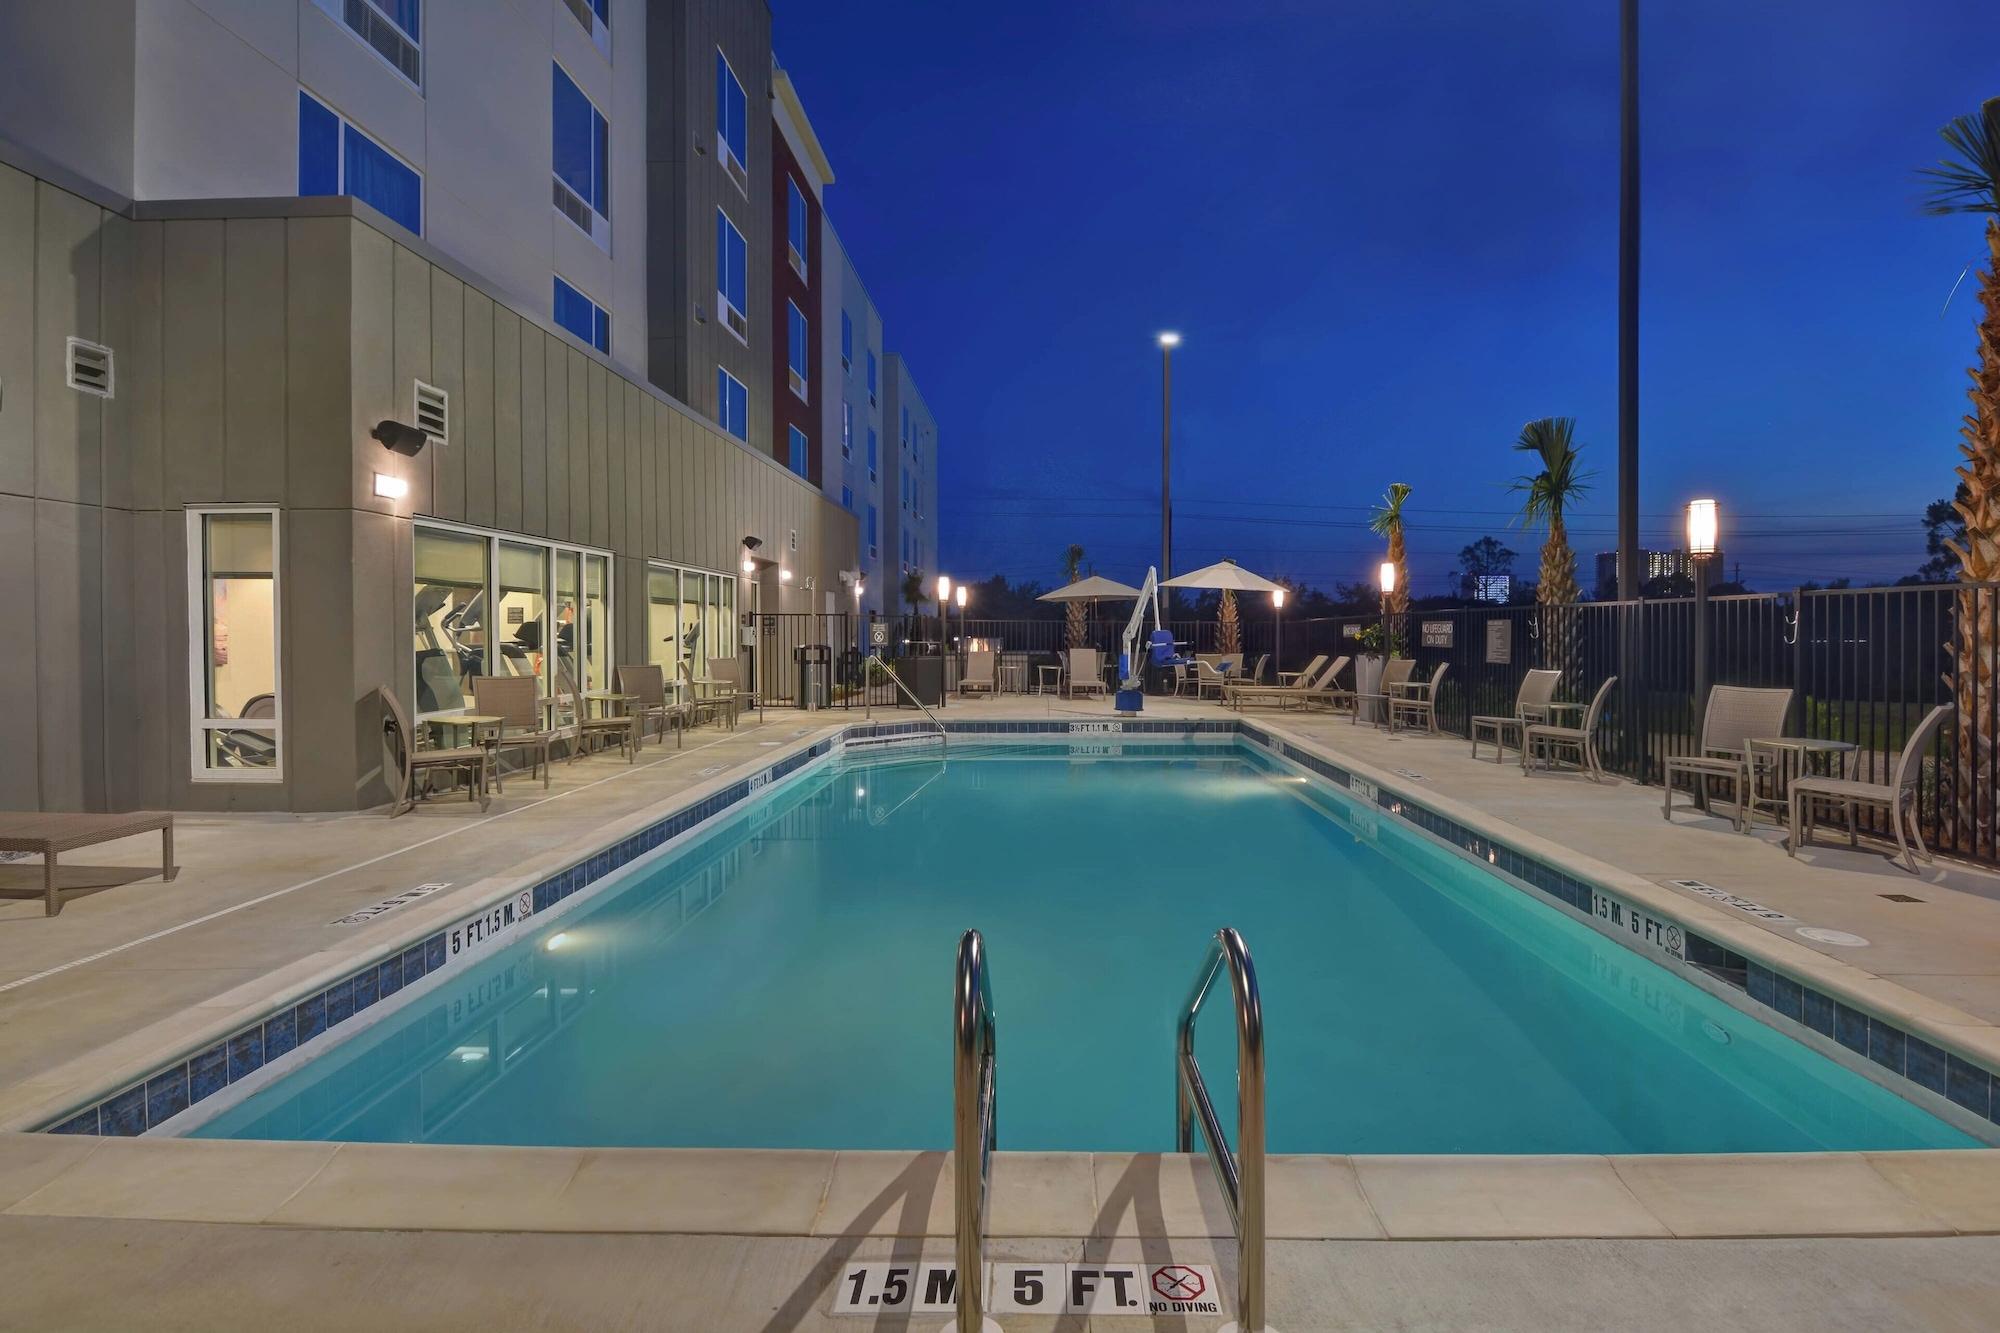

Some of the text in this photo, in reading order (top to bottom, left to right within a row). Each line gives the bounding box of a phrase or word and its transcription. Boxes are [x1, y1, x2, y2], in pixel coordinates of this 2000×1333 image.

[452, 930, 461, 955] 5
[467, 918, 483, 948] FT.
[486, 908, 500, 936] 1.5
[503, 902, 515, 927] M.
[1593, 894, 1663, 947] 1.5 M. 5 FT.
[848, 1269, 909, 1305] 1.5
[1013, 1270, 1045, 1305] 5
[1072, 1270, 1138, 1307] FT.
[1149, 1302, 1218, 1313] NO DIVING
